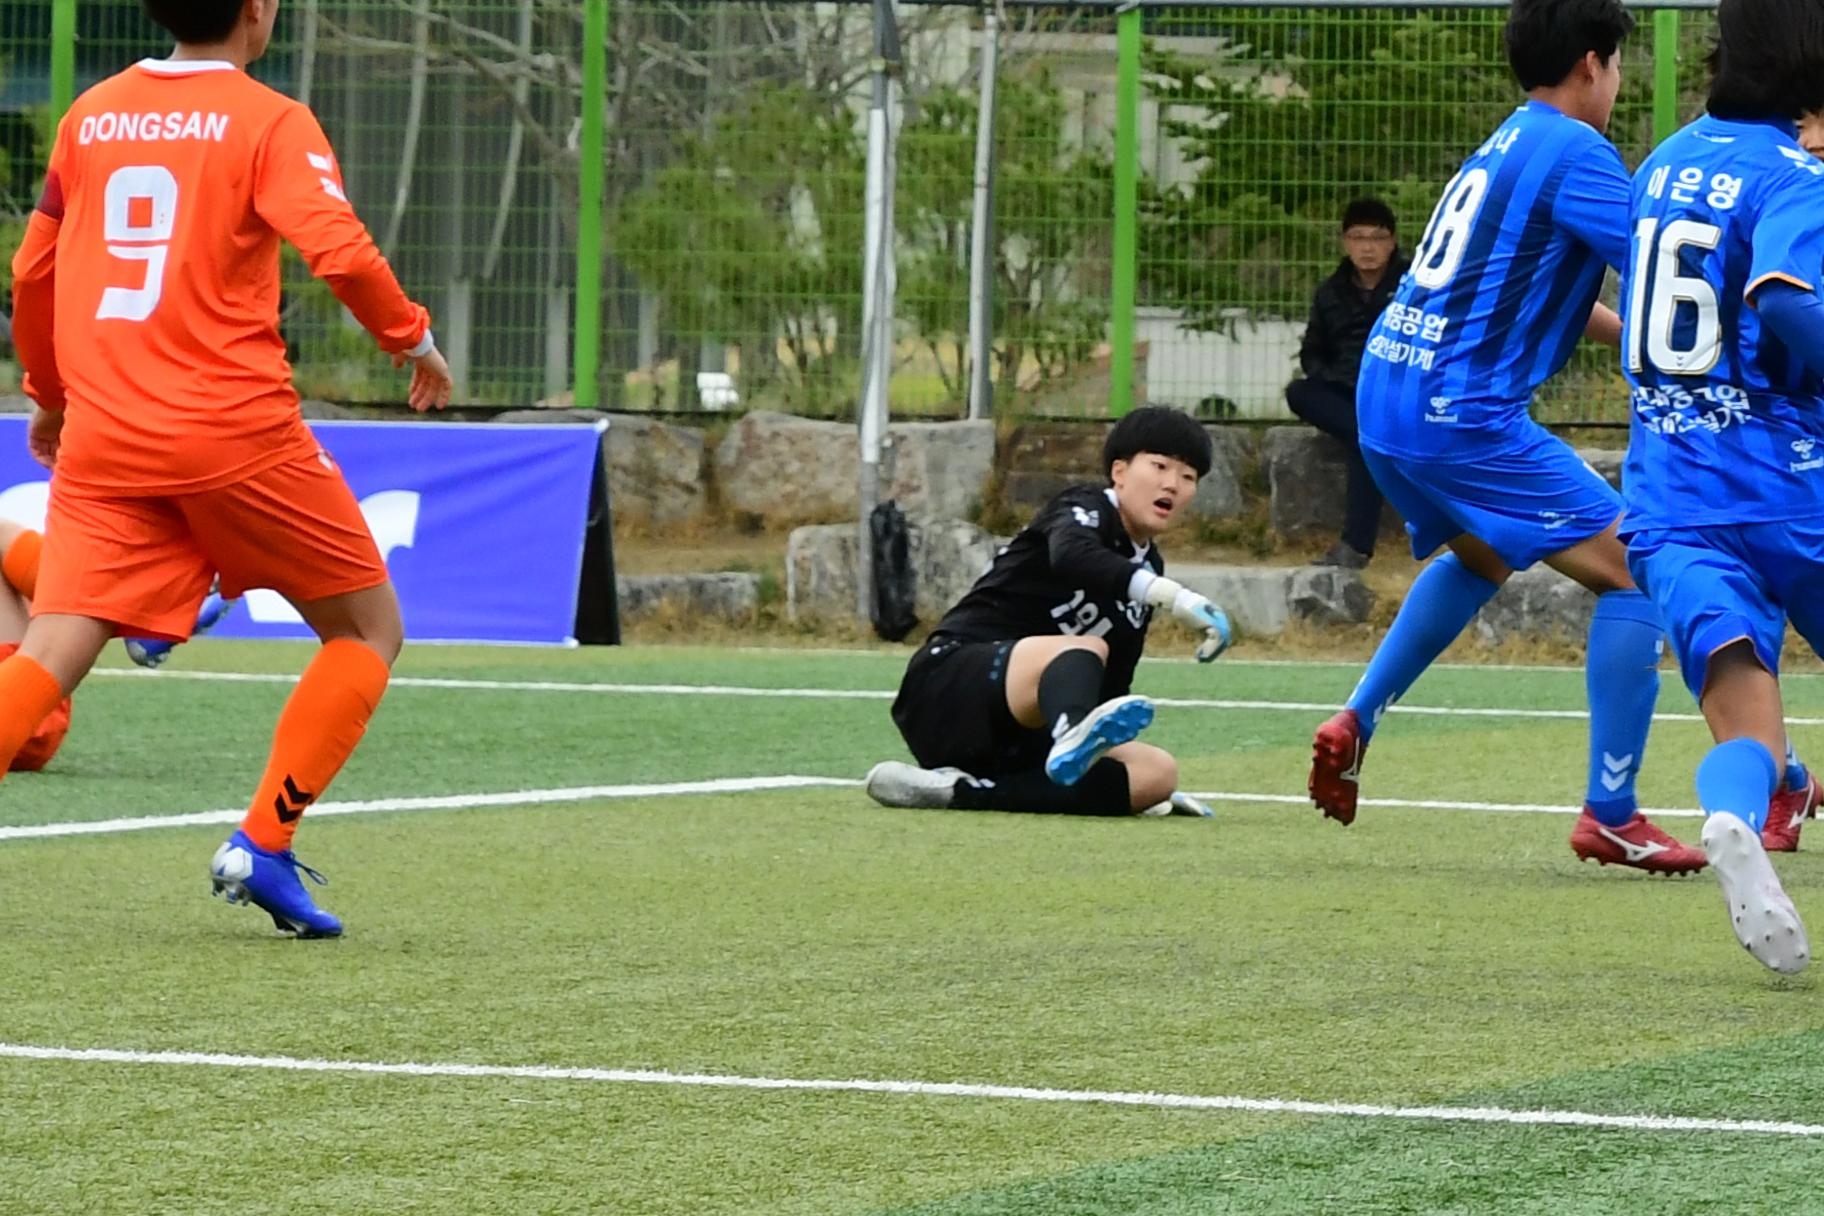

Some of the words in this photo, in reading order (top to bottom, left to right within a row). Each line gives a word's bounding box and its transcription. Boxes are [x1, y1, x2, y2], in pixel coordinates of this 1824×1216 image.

[78, 112, 229, 145] DONGSAN
[1647, 165, 1742, 210] 이은영
[95, 165, 178, 321] 9
[1628, 217, 1722, 375] 16
